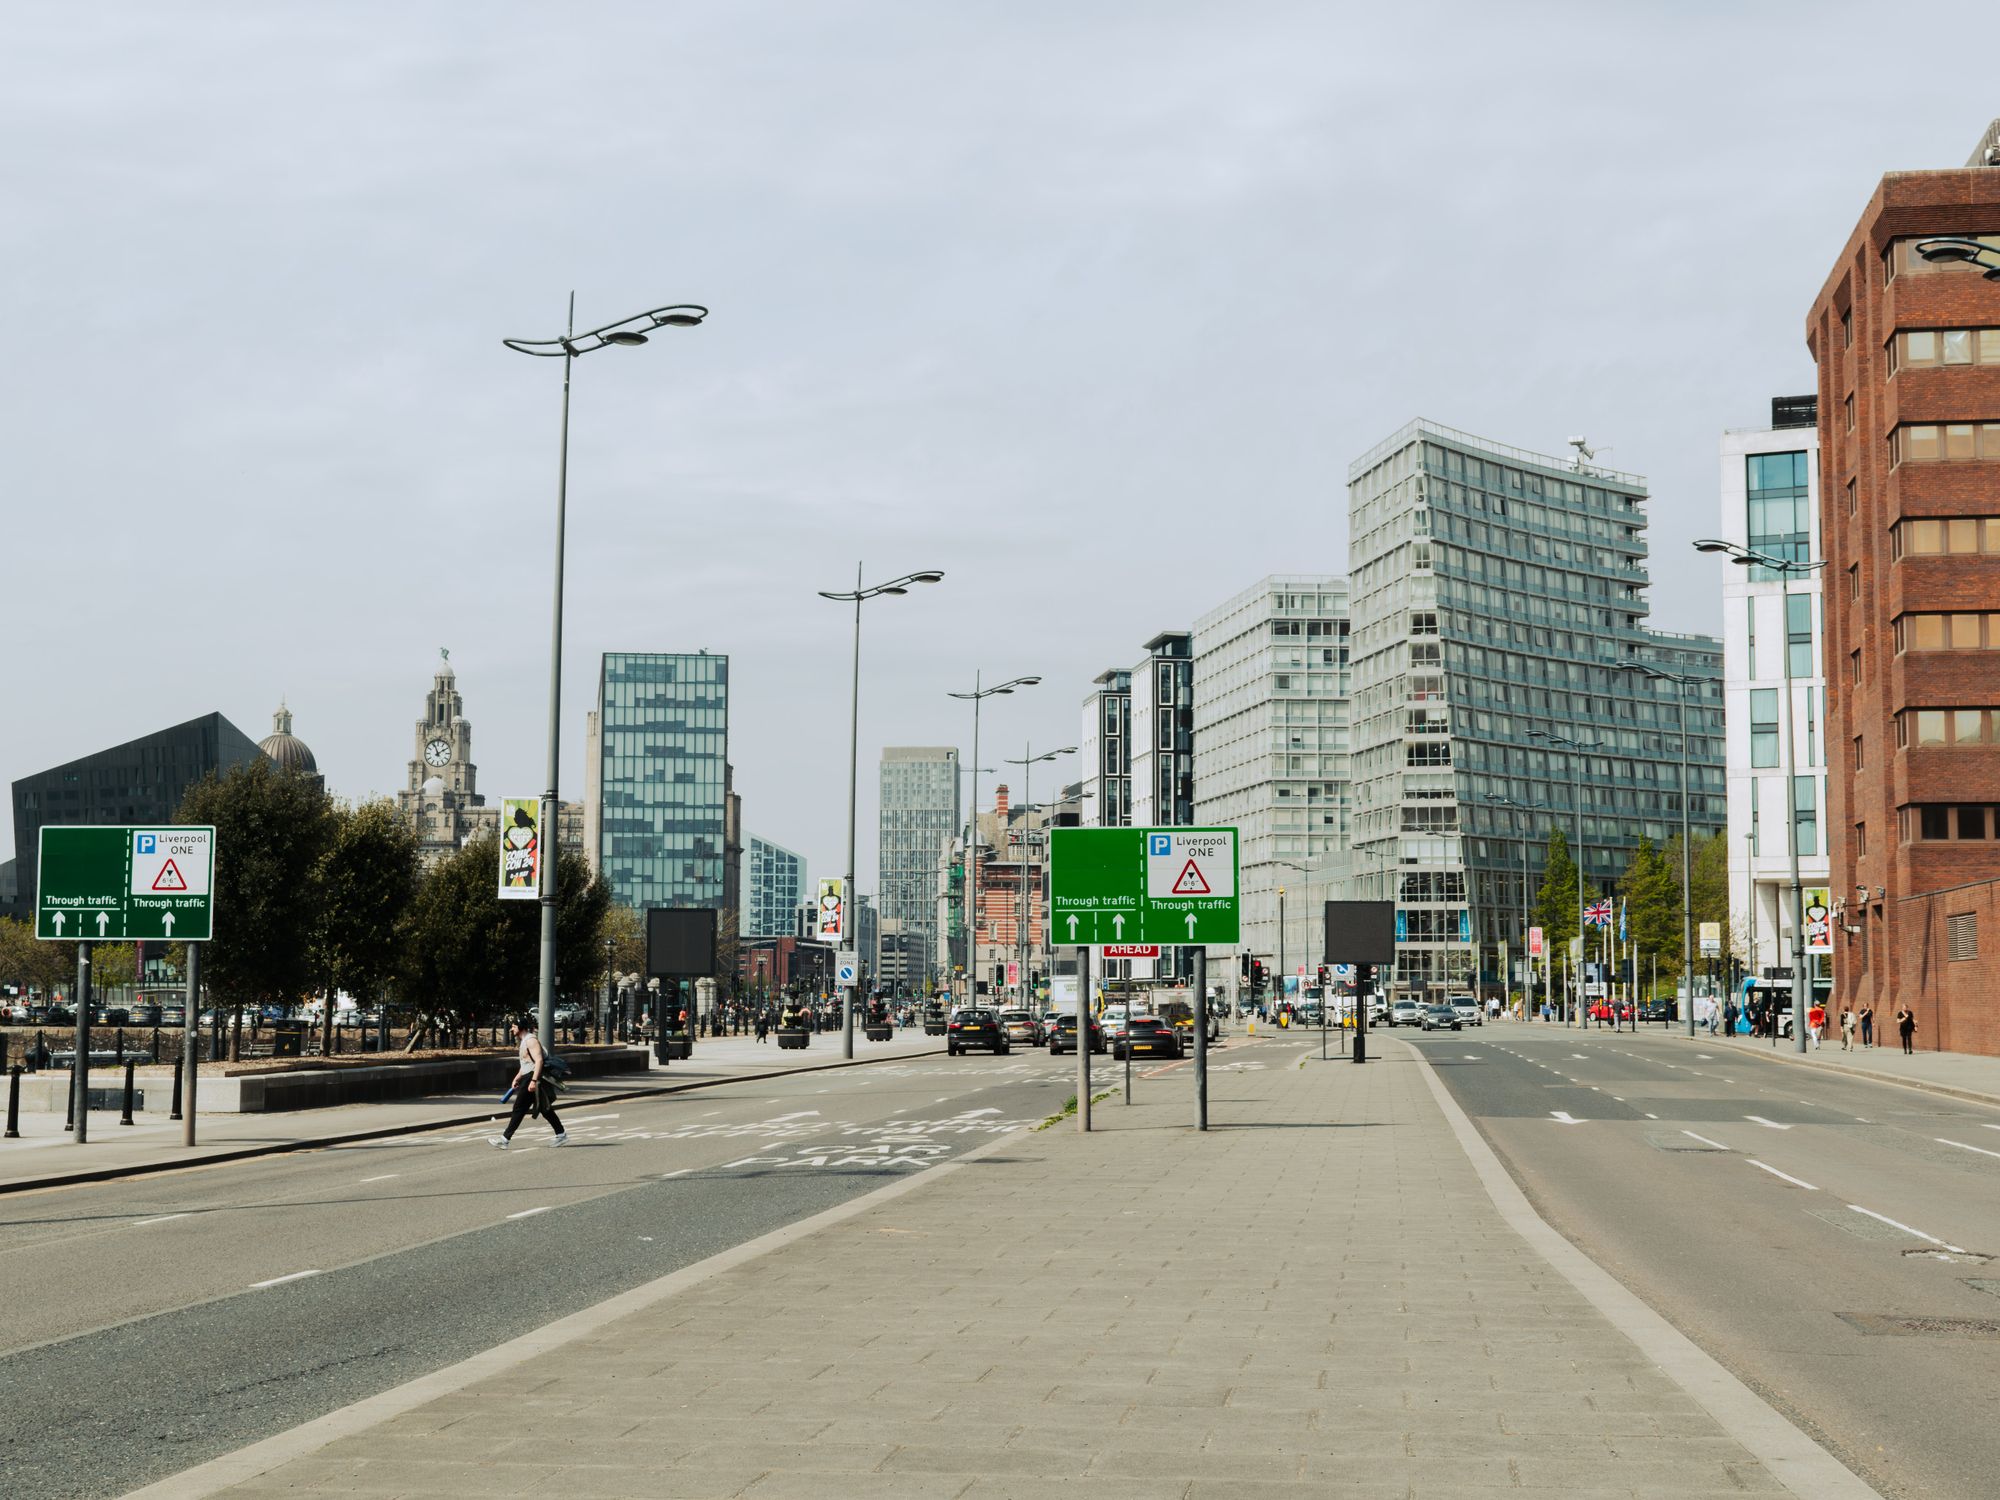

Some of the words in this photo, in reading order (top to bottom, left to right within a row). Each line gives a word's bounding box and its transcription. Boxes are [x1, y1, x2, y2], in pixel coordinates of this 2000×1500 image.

[141, 836, 154, 853] P
[159, 834, 207, 845] Liverpool
[1155, 837, 1168, 854] P
[1176, 836, 1227, 847] Liverpool
[170, 846, 194, 855] ONE
[1188, 848, 1214, 857] ONE
[45, 895, 85, 906] Through
[87, 895, 117, 905] traffic
[133, 898, 172, 909] Through
[175, 898, 205, 908] traffic
[1055, 896, 1099, 907] Through
[1102, 896, 1136, 906] traffic
[1150, 900, 1194, 911] Through
[1197, 900, 1231, 910] traffic
[1110, 945, 1151, 954] AHEAD
[841, 1126, 1022, 1135] TRAFFIC
[796, 1144, 953, 1155] CAR
[721, 1155, 949, 1168] PARK
